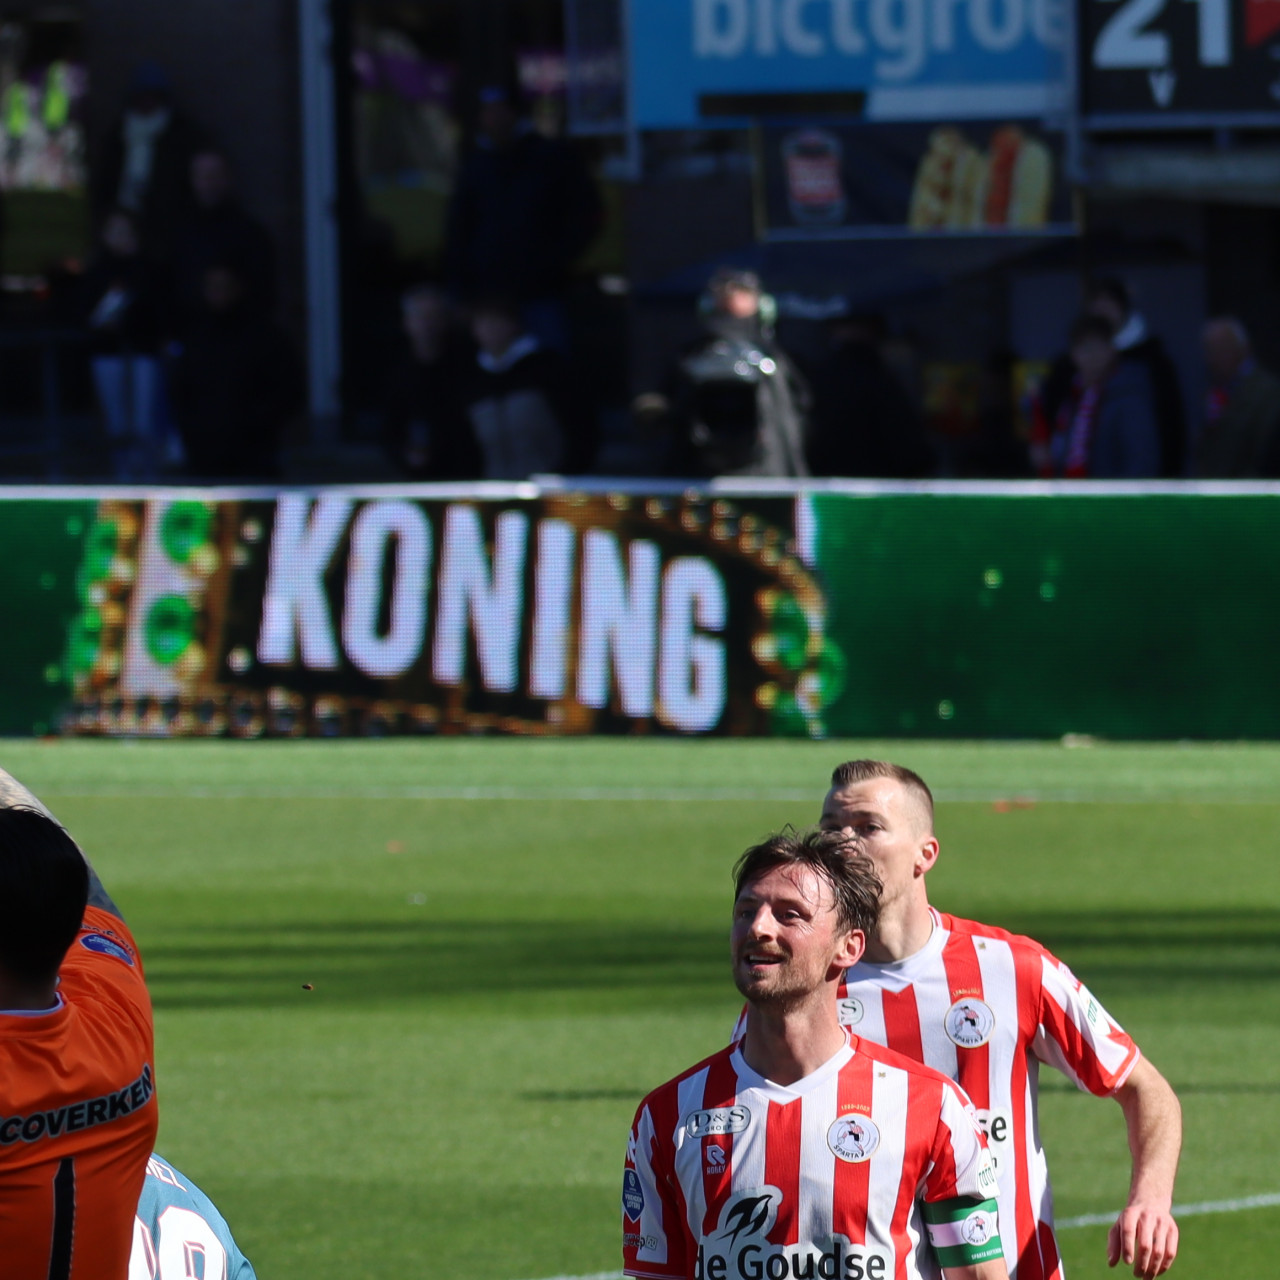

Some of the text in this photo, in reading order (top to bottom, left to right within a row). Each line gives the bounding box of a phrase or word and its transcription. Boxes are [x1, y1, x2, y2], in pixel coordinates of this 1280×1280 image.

[257, 494, 727, 733] KONING
[694, 1107, 745, 1128] D&S
[834, 1144, 860, 1160] SPARTA
[706, 1164, 726, 1175] ROBEY
